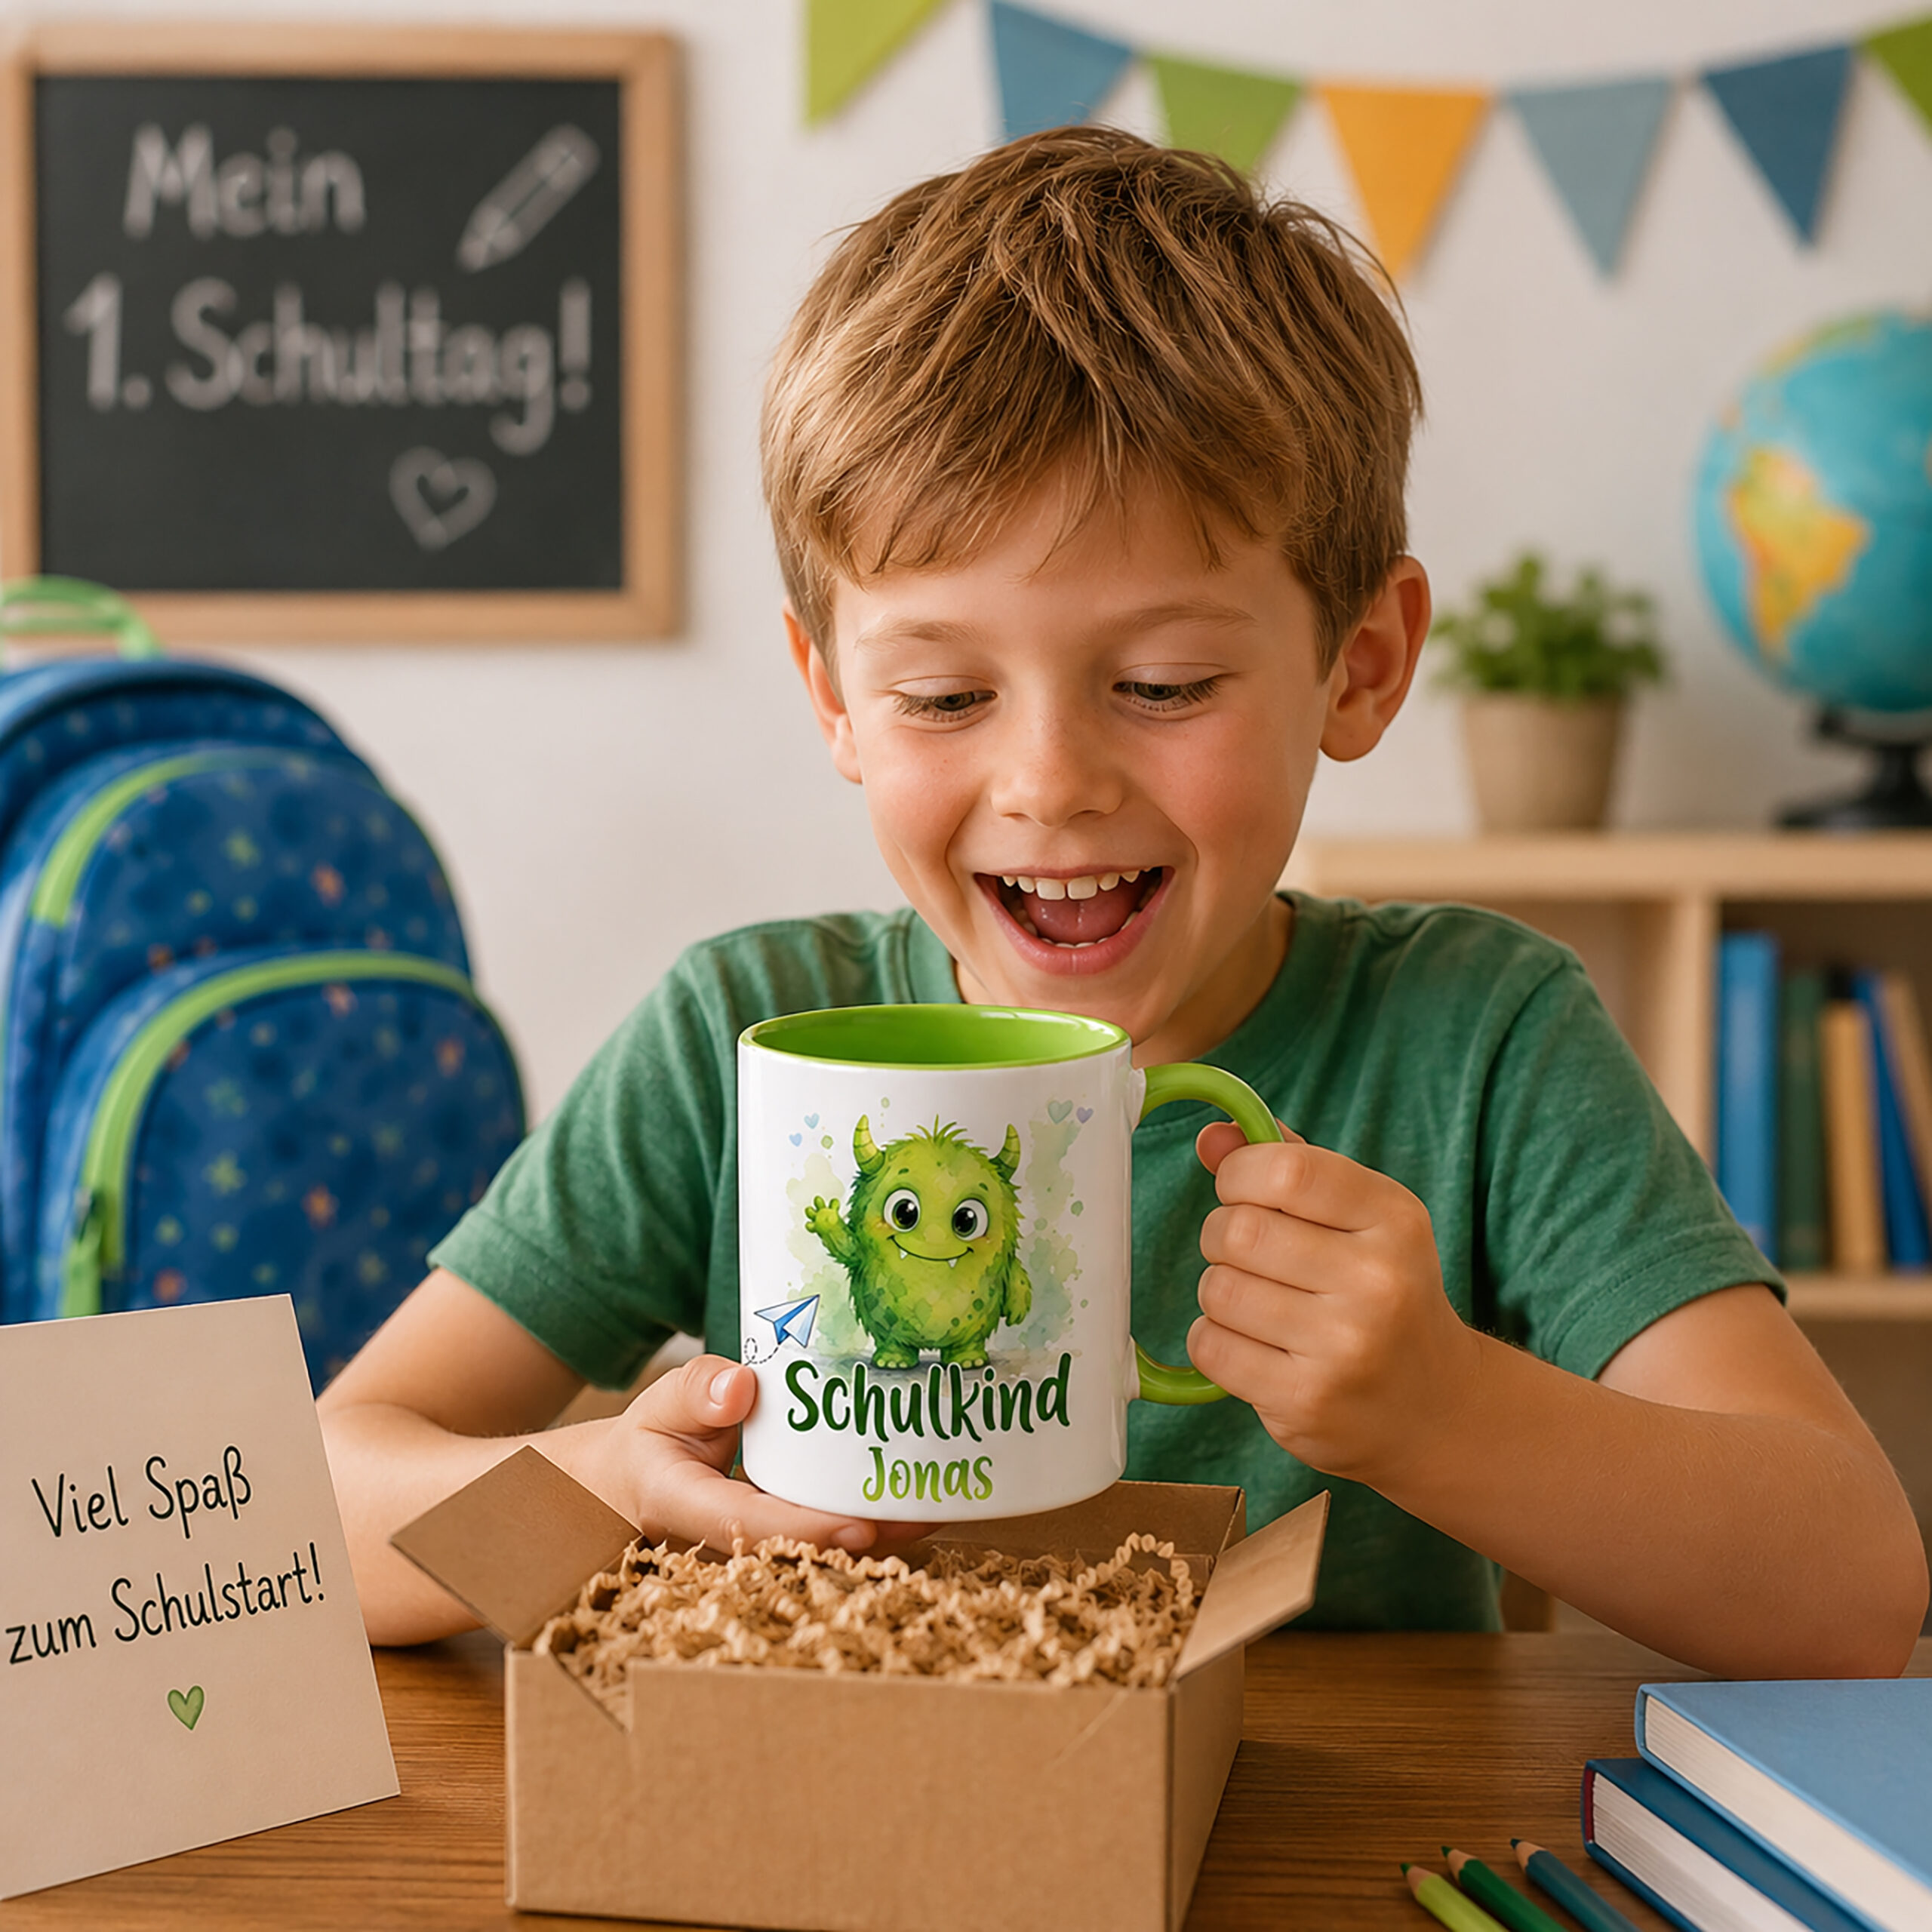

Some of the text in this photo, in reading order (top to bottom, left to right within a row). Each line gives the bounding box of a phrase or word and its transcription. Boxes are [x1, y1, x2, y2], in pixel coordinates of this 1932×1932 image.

[124, 122, 365, 237] Mein
[64, 272, 592, 455] 1. Schultag!
[786, 1353, 1072, 1442] Schulkind
[32, 1445, 252, 1539] Viel Spaß
[863, 1446, 993, 1503] Jonas
[5, 1542, 325, 1663] zum Schulstart!
